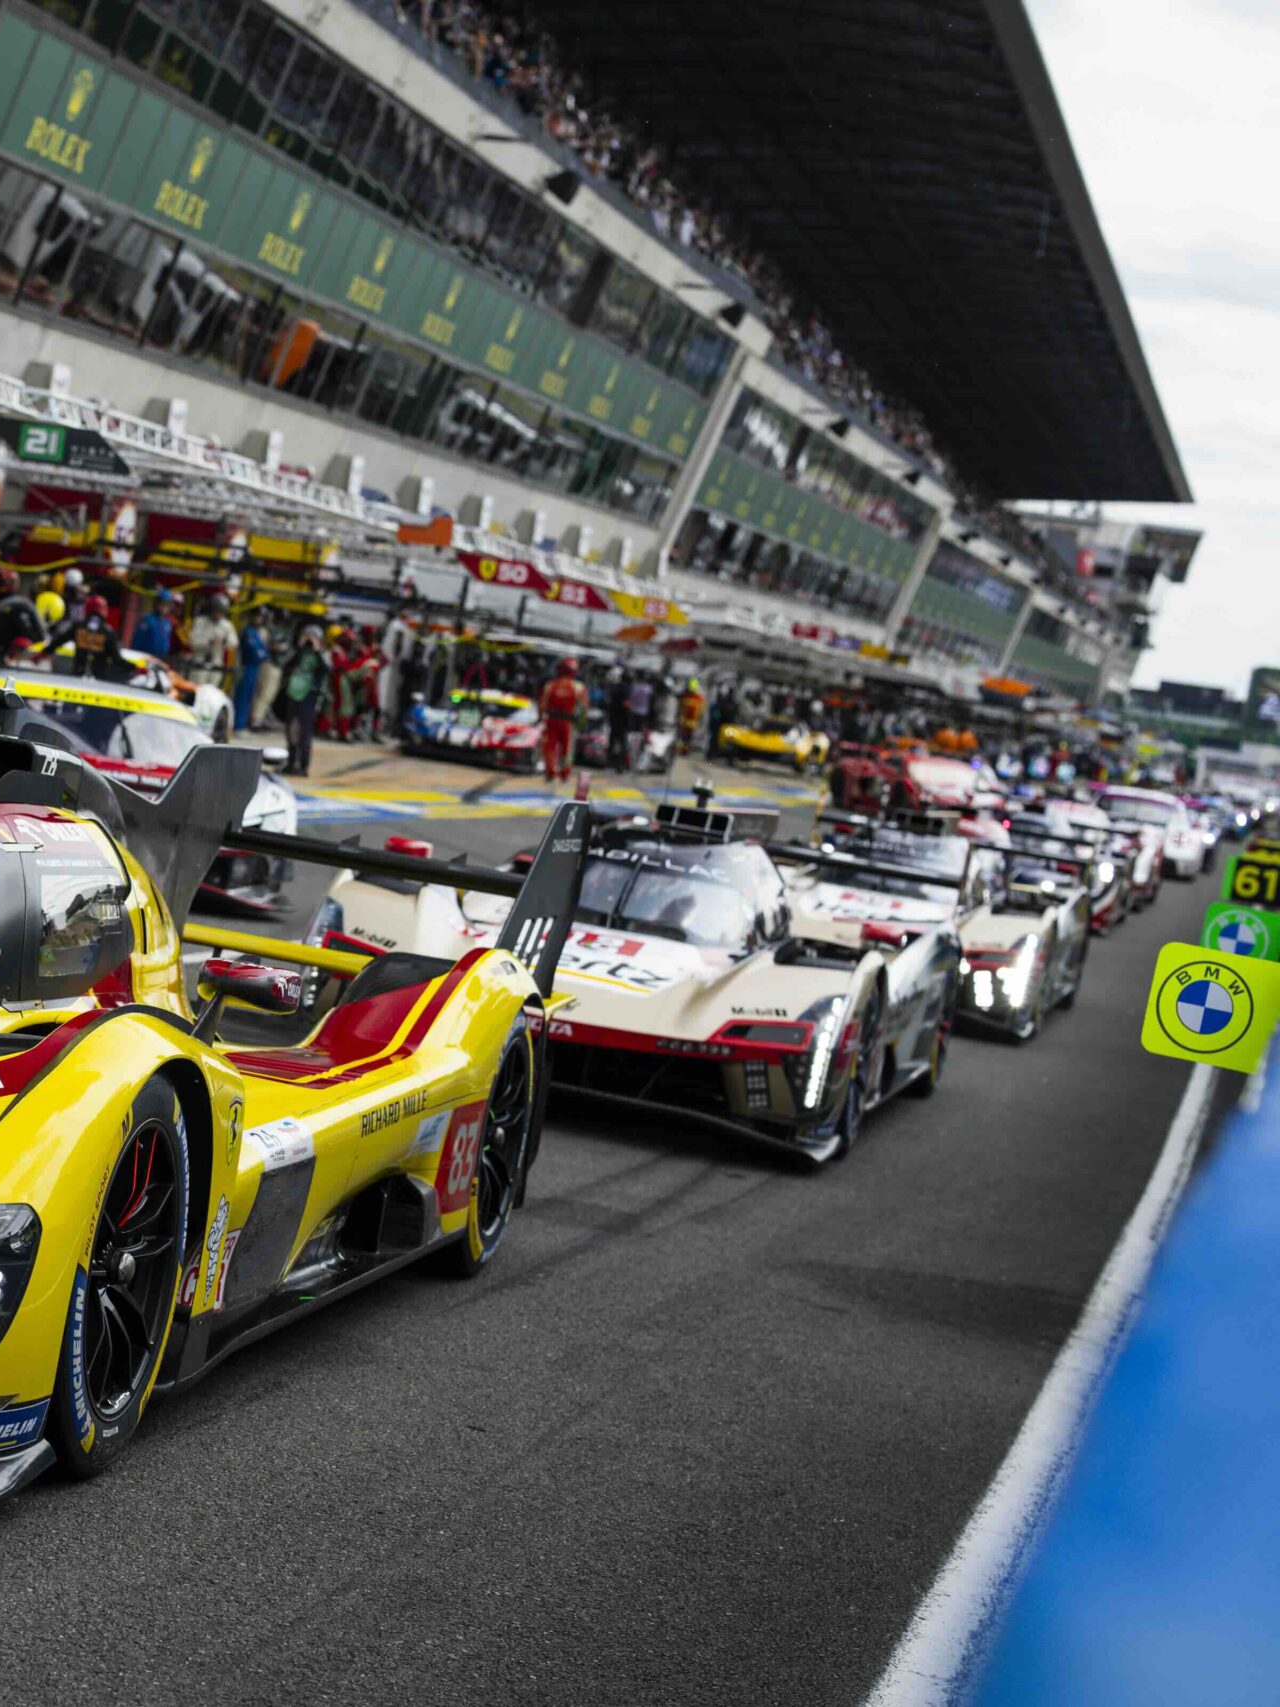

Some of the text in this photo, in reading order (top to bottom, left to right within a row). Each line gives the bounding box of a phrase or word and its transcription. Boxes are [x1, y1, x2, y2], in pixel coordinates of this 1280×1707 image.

[25, 116, 92, 174] ROLEX
[154, 180, 209, 230] ROLEX
[24, 427, 60, 455] 21
[497, 562, 529, 584] 50
[587, 845, 732, 884] ADILLAC
[1234, 864, 1279, 903] 61
[558, 952, 673, 989] ertz
[1175, 966, 1246, 998] BMW
[361, 1101, 401, 1138] RICHARD
[403, 1090, 428, 1119] MILLE
[447, 1121, 480, 1196] 83
[95, 1163, 111, 1210] SPORT
[84, 1216, 97, 1259] PILOT
[72, 1286, 86, 1421] MICHELIN
